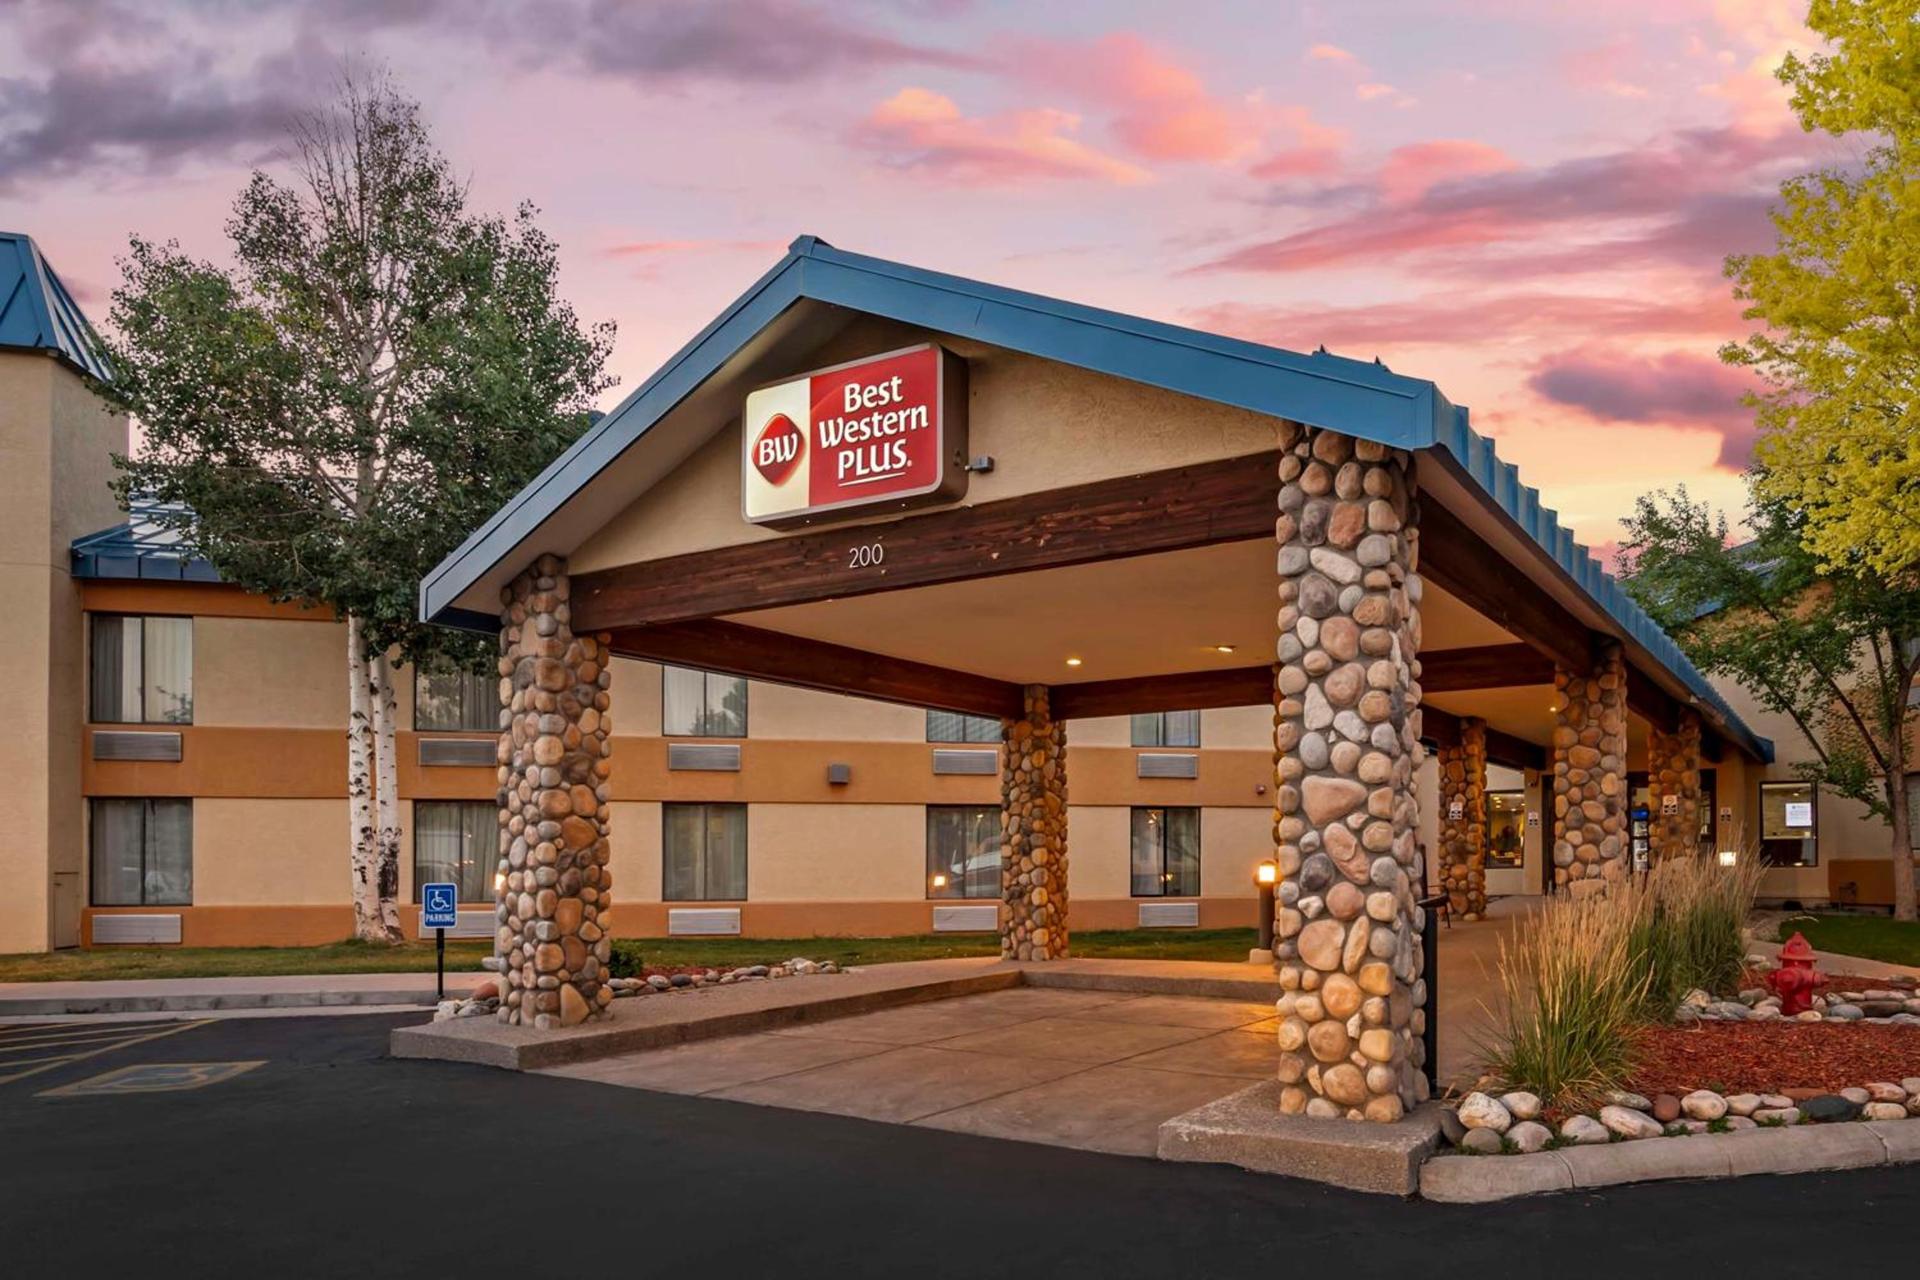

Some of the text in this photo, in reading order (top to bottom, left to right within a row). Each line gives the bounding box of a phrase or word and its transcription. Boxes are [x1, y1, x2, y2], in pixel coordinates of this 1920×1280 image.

[844, 376, 903, 413] Best
[818, 405, 928, 449] Western
[758, 433, 798, 466] BW
[849, 544, 883, 568] 200
[426, 913, 455, 922] PARKING
